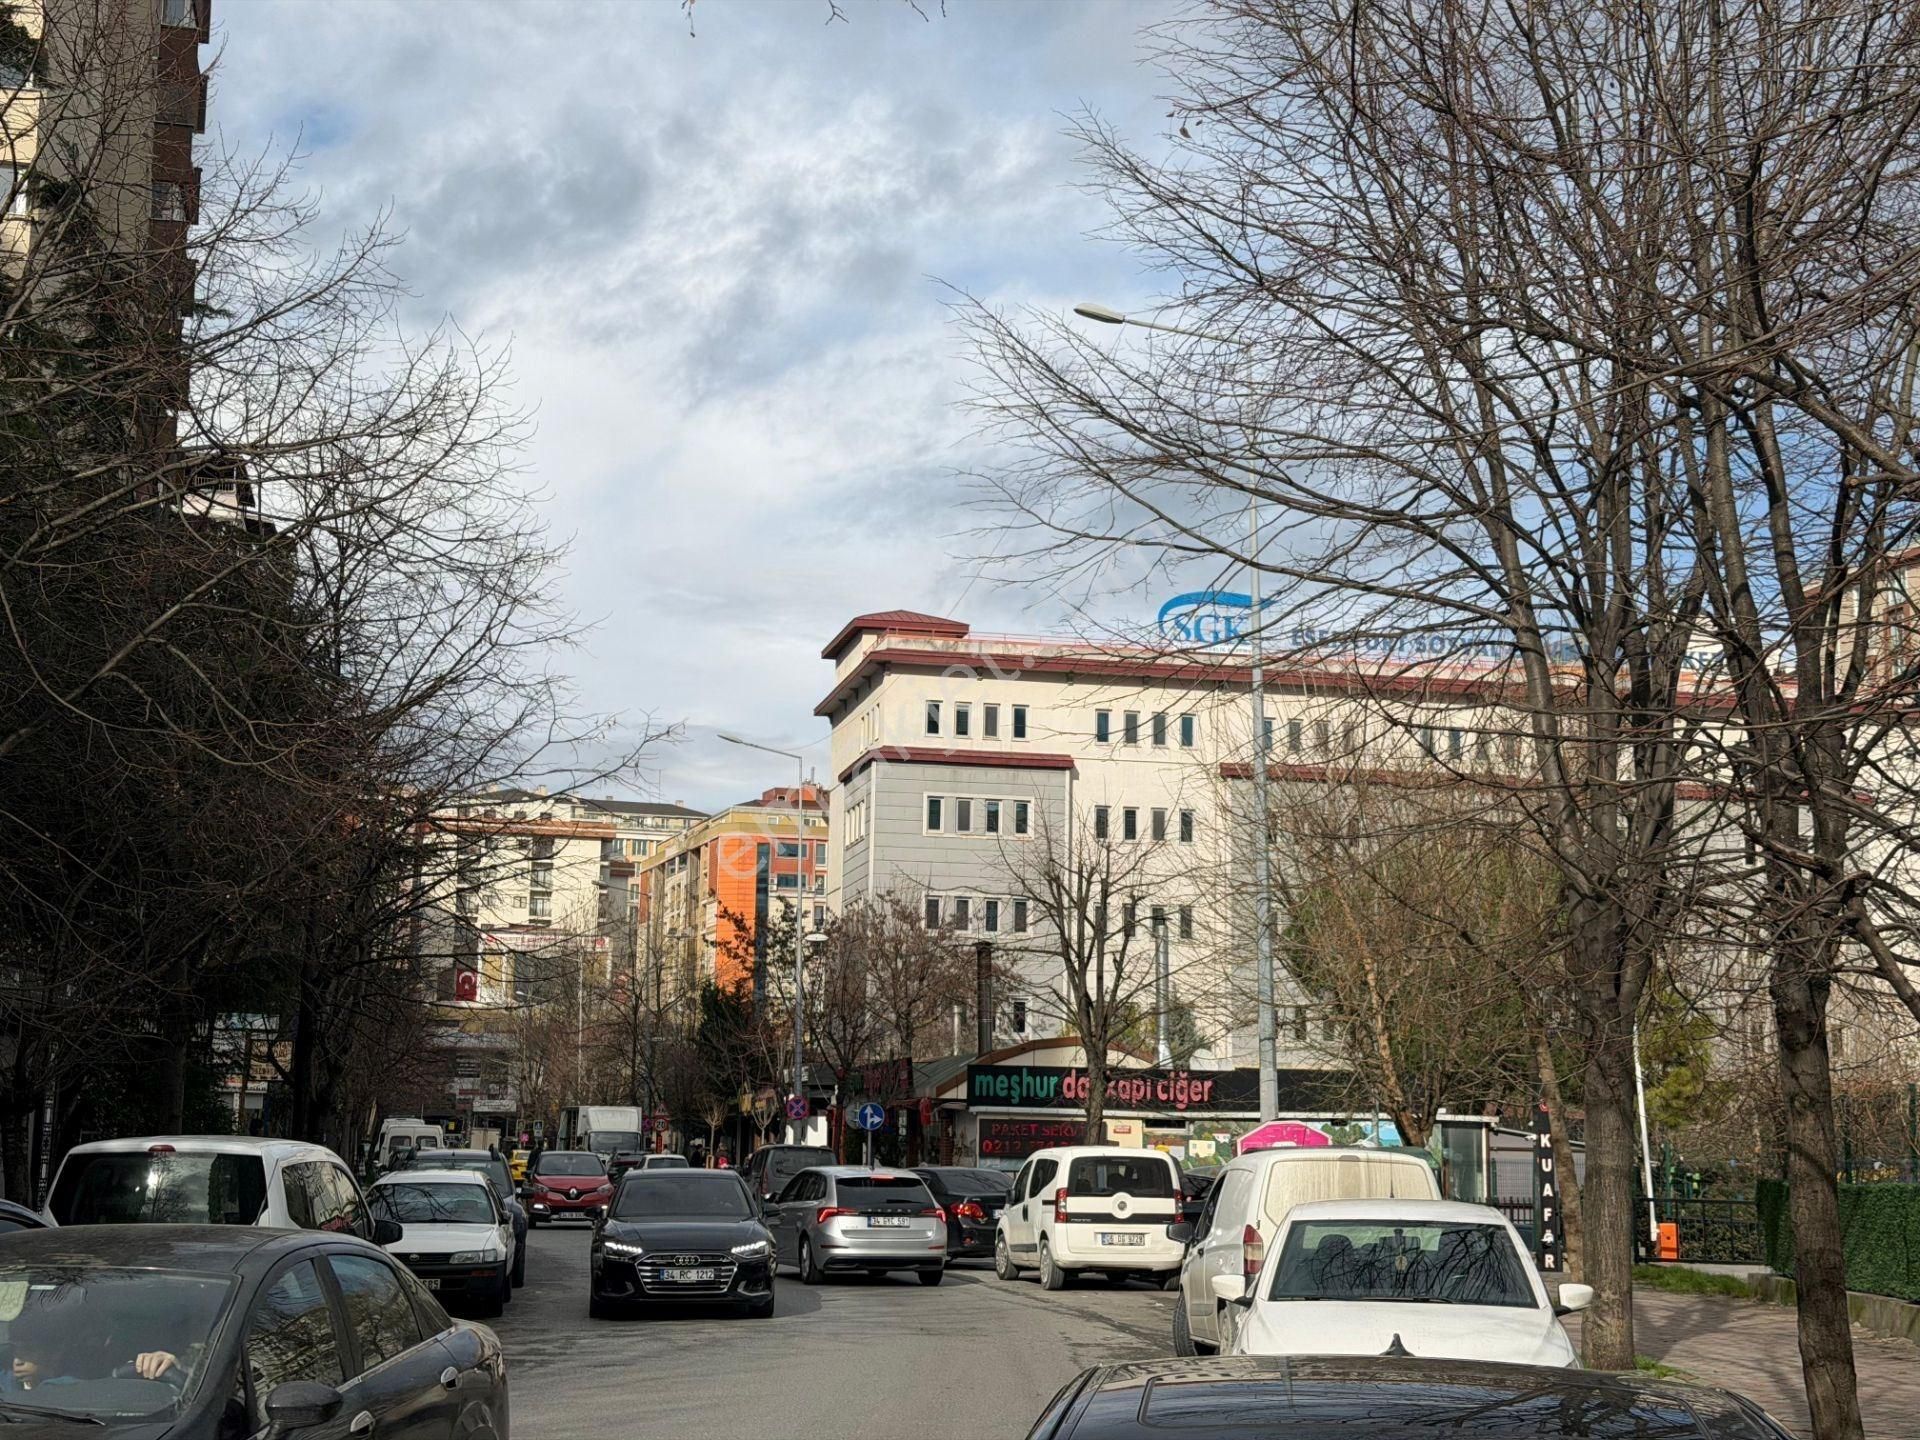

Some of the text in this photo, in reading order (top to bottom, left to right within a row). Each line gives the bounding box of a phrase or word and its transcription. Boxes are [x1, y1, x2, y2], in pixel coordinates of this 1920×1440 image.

[1173, 614, 1252, 645] SGK
[975, 1067, 1059, 1105] meşhur
[1157, 1069, 1214, 1110] ciğer
[991, 1123, 1039, 1136] PAKET
[982, 1139, 1022, 1153] 0212
[872, 1217, 880, 1225] 34
[665, 1270, 714, 1280] 34 RC 1212
